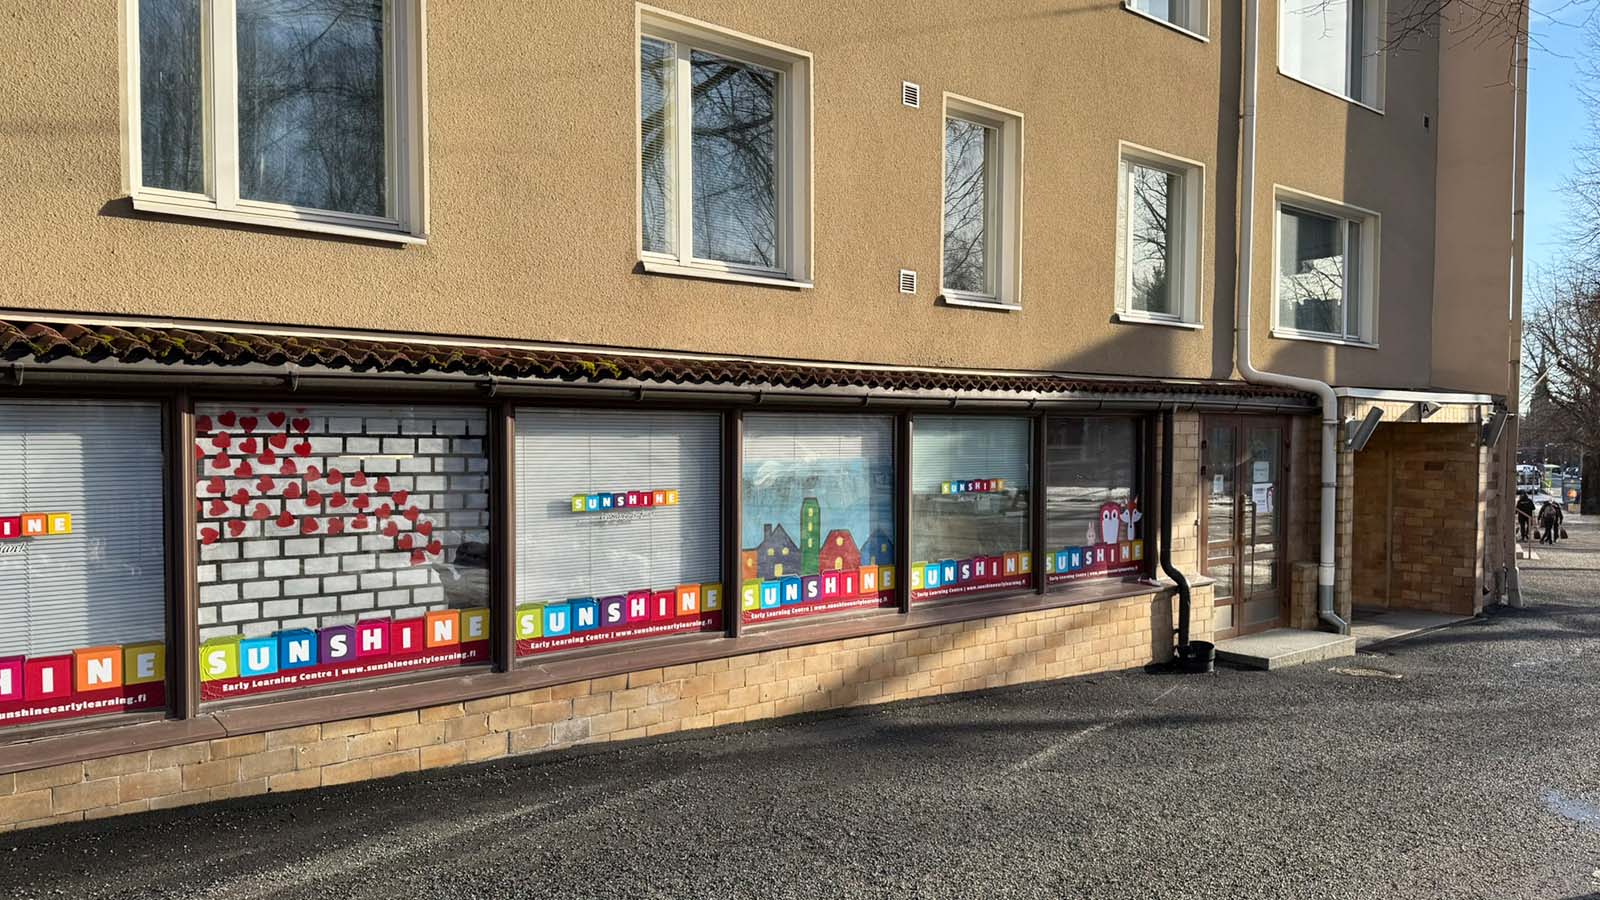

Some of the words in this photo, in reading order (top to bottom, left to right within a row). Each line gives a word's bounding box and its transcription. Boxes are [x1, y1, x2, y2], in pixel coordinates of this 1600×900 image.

[1422, 403, 1430, 413] A
[576, 494, 675, 509] SUNSHINE
[912, 556, 1029, 586] SUNSHINE
[1046, 545, 1140, 571] SUNSHINE
[744, 571, 891, 607] SUNSHINE
[521, 589, 718, 635] SUNSHINE
[207, 615, 483, 675] SUNSHINE
[530, 639, 550, 649] Early
[552, 634, 584, 646] Learning
[586, 631, 609, 641] Centre
[222, 680, 249, 692] Early
[252, 671, 297, 688] Learning
[300, 668, 332, 681] Centre
[342, 650, 476, 675] www.sunshineearlylearning.fi
